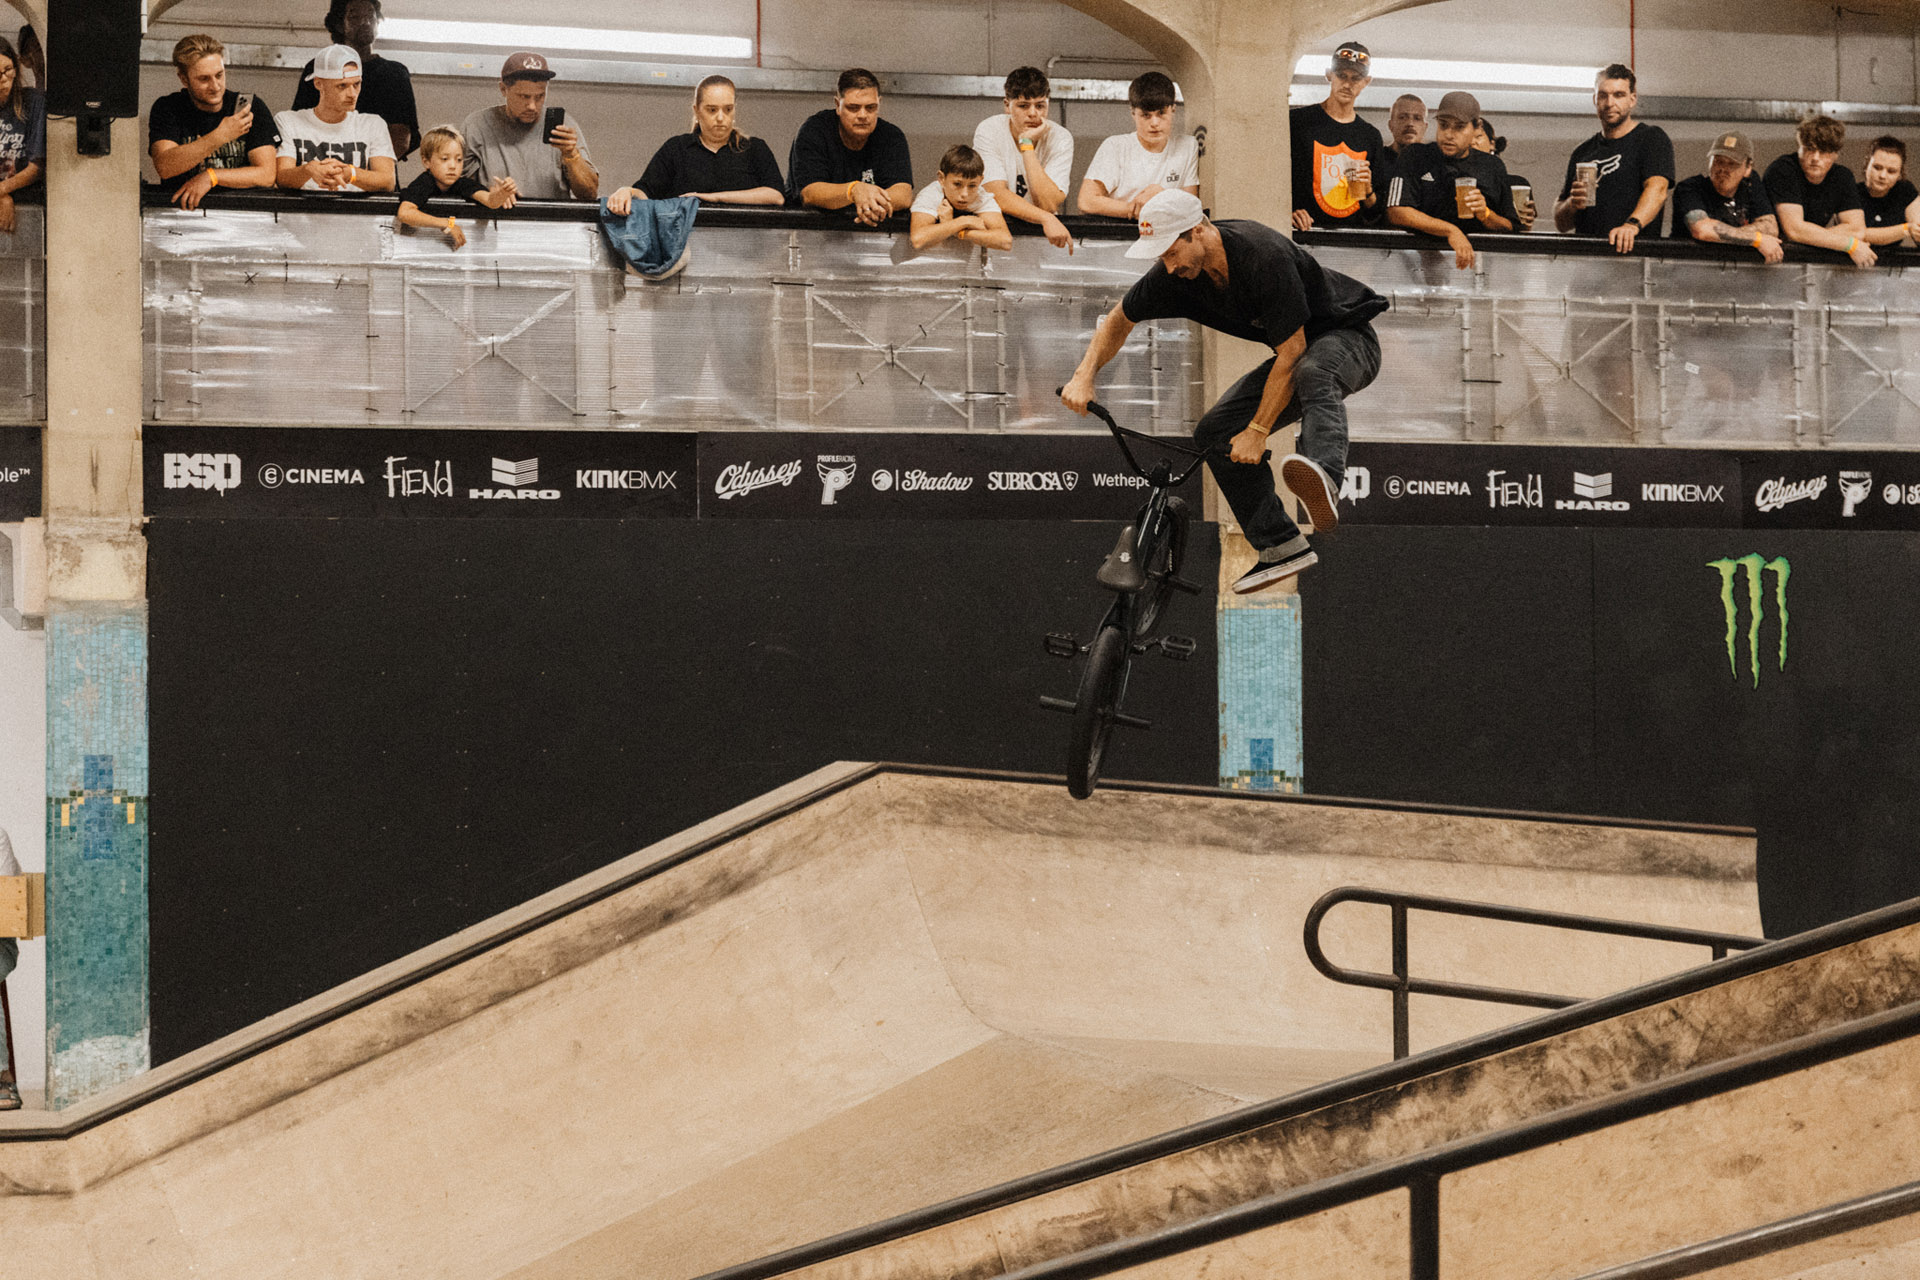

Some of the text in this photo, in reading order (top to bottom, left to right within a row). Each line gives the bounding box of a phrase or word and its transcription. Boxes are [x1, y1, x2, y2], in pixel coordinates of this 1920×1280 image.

[164, 453, 241, 497] BSD
[286, 469, 365, 484] CINEMA
[715, 459, 802, 499] Odyssey
[901, 469, 973, 491] Shadow
[987, 471, 1063, 491] SUBROSA
[469, 489, 561, 500] HARO
[1406, 480, 1471, 495] CINEMA
[1755, 475, 1828, 512] Odyssey
[1555, 500, 1630, 511] HARO
